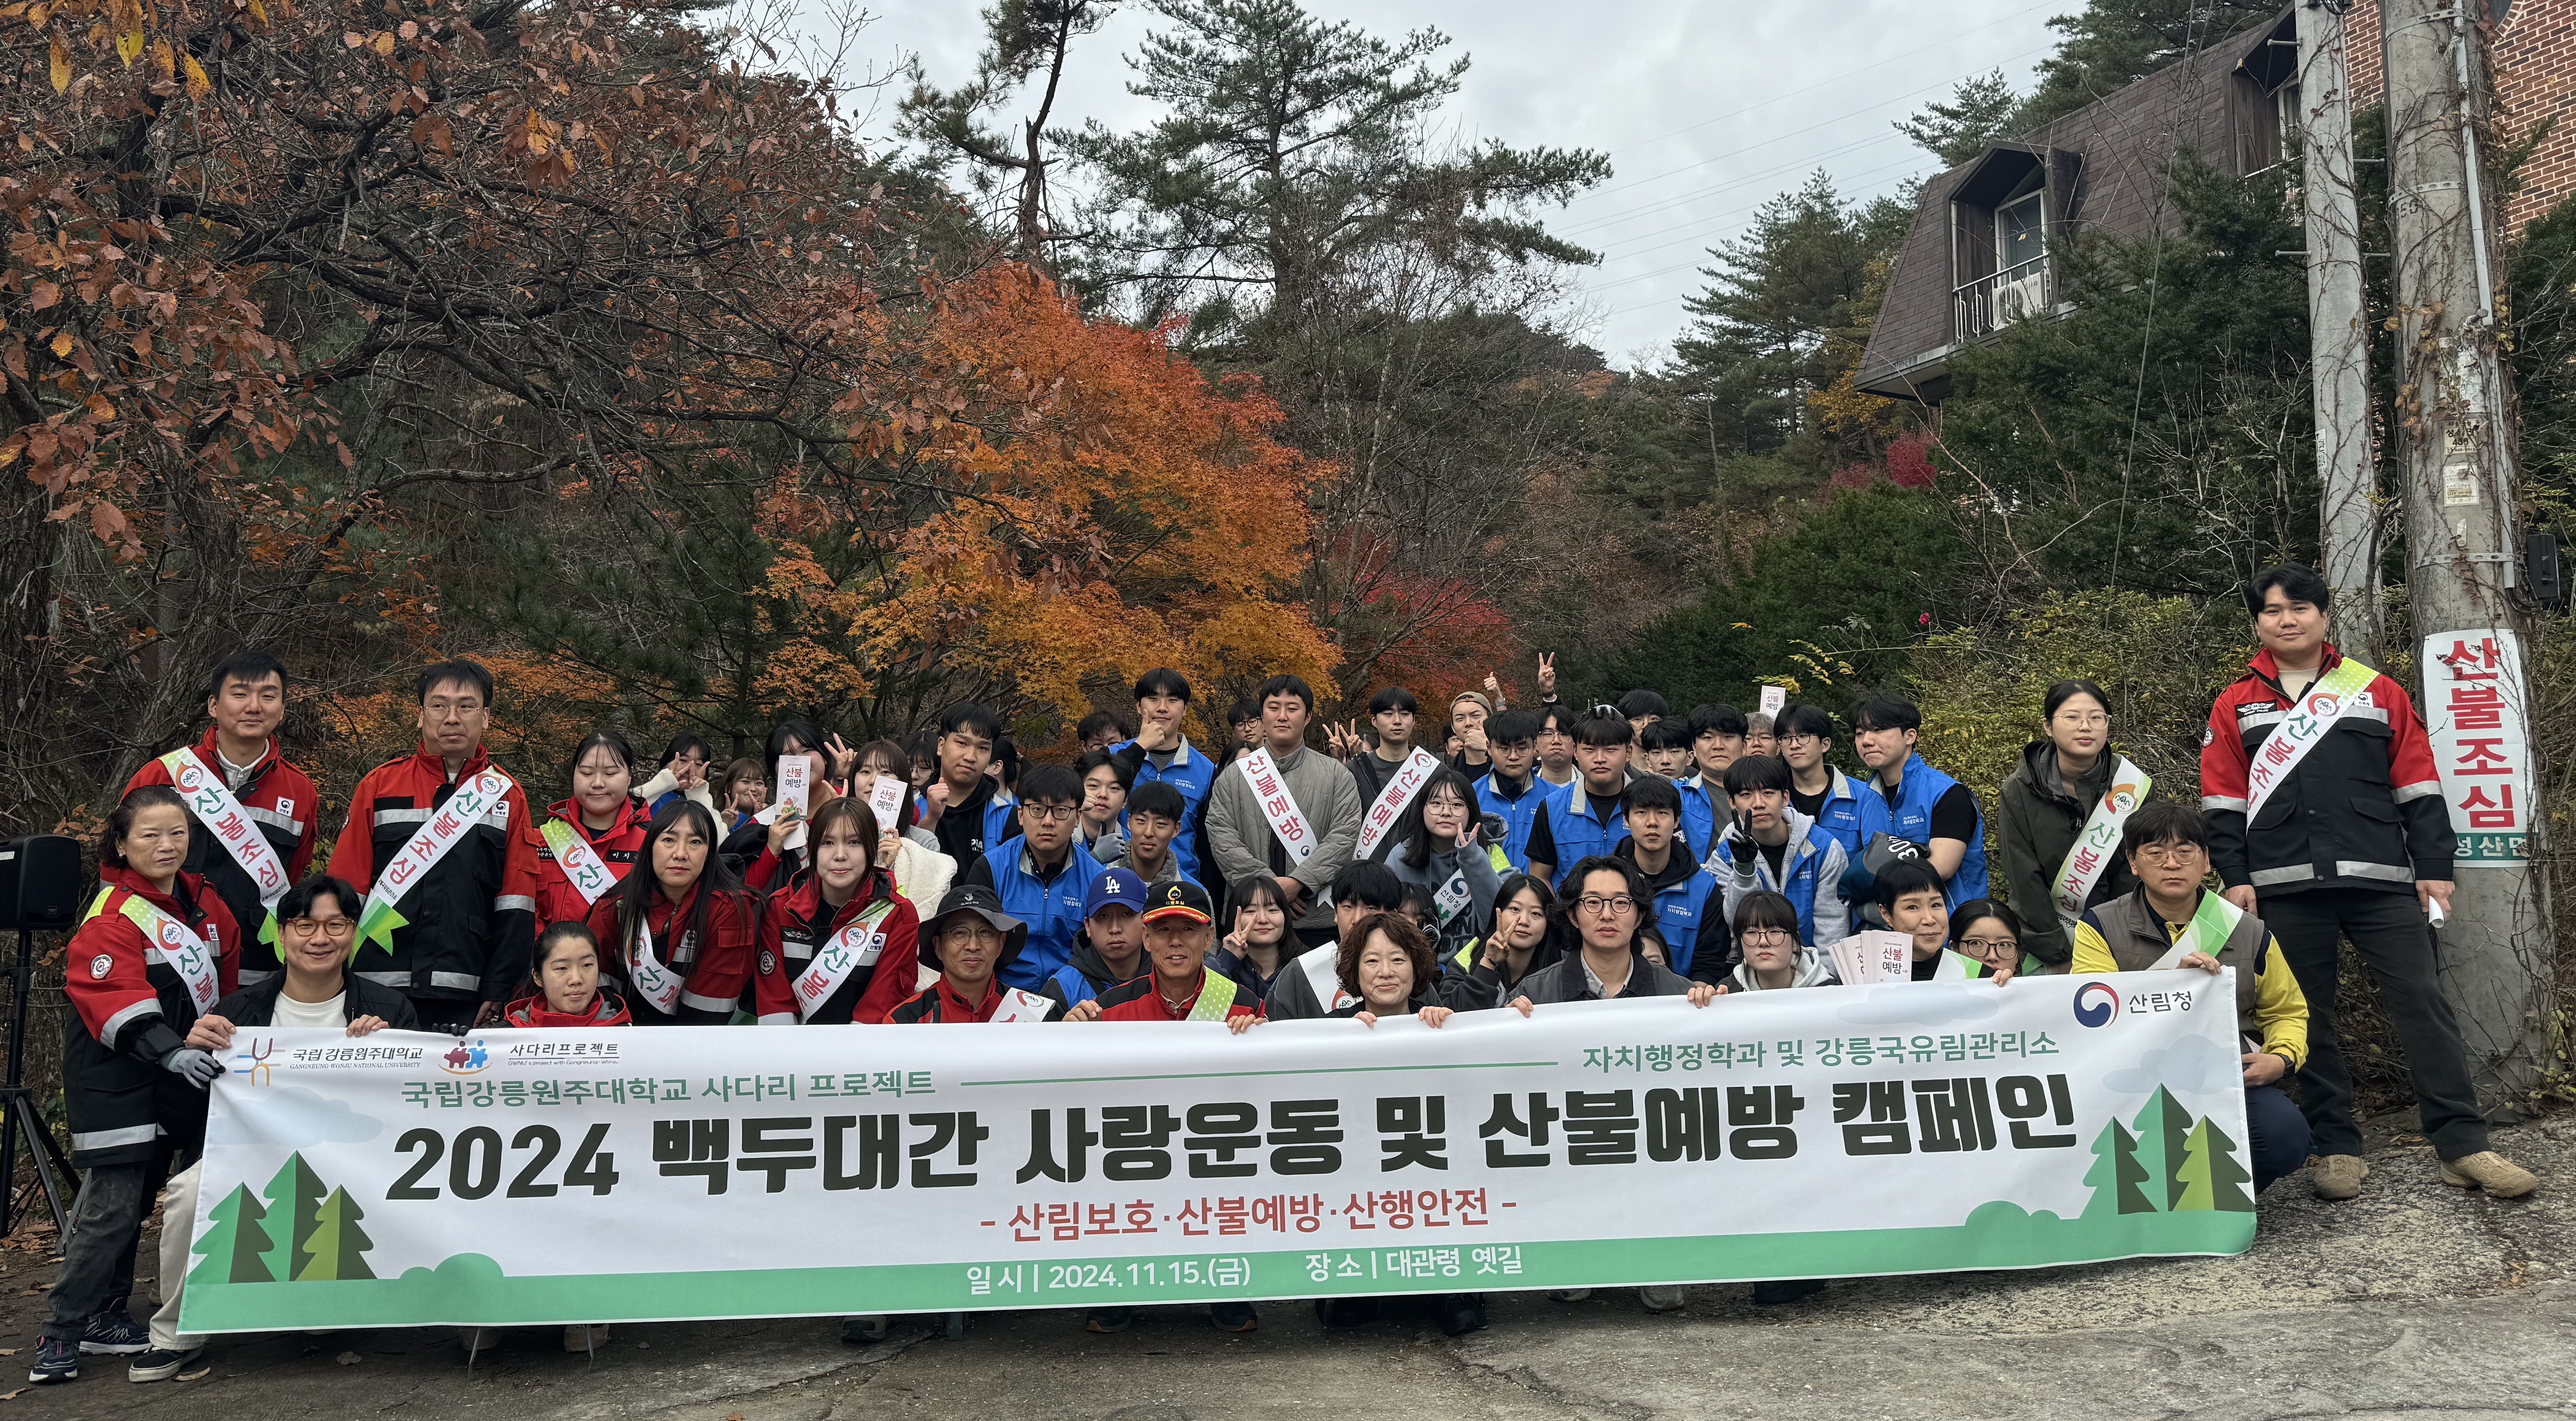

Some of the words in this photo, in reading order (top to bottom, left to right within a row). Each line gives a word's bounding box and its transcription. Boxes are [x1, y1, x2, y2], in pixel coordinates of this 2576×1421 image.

[2442, 638, 2515, 828] 산불조심
[785, 778, 802, 788] 예방
[786, 767, 803, 778] 산불
[877, 800, 893, 811] 예방
[880, 789, 896, 801] 산불
[1246, 755, 1304, 842] 산불예방
[1362, 768, 1422, 846] 산불예방
[195, 787, 279, 888] 산불조심
[390, 790, 482, 885] 산불조심
[2057, 822, 2115, 912] 산불조심
[1106, 876, 1120, 893] LA
[1882, 961, 1903, 975] 예방
[1883, 947, 1903, 961] 산불
[2129, 991, 2192, 1014] 산림청
[292, 1049, 323, 1061] 국립
[325, 1047, 423, 1061] 강릉원주대학교
[510, 1043, 618, 1056] 사다리프로젝트
[1583, 1042, 1767, 1073] 자치행정학과
[1777, 1040, 1803, 1066] 및
[1816, 1032, 2060, 1067] 강릉국유림관리소
[401, 1076, 692, 1109] 국립강릉원주대학교
[701, 1074, 796, 1102] 사다리
[808, 1071, 935, 1098] 프로젝트
[385, 1123, 620, 1200] 2024
[652, 1111, 989, 1195] 백두대간
[1016, 1099, 1344, 1184] 사랑운동
[1376, 1095, 1449, 1172] 및
[1479, 1085, 1805, 1168] 산불예방
[1833, 1074, 2077, 1156] 캠페인
[1049, 1257, 1251, 1289] 2024.11.15.(금)
[1386, 1248, 1461, 1278] 대관령
[1471, 1245, 1523, 1275] 옛길
